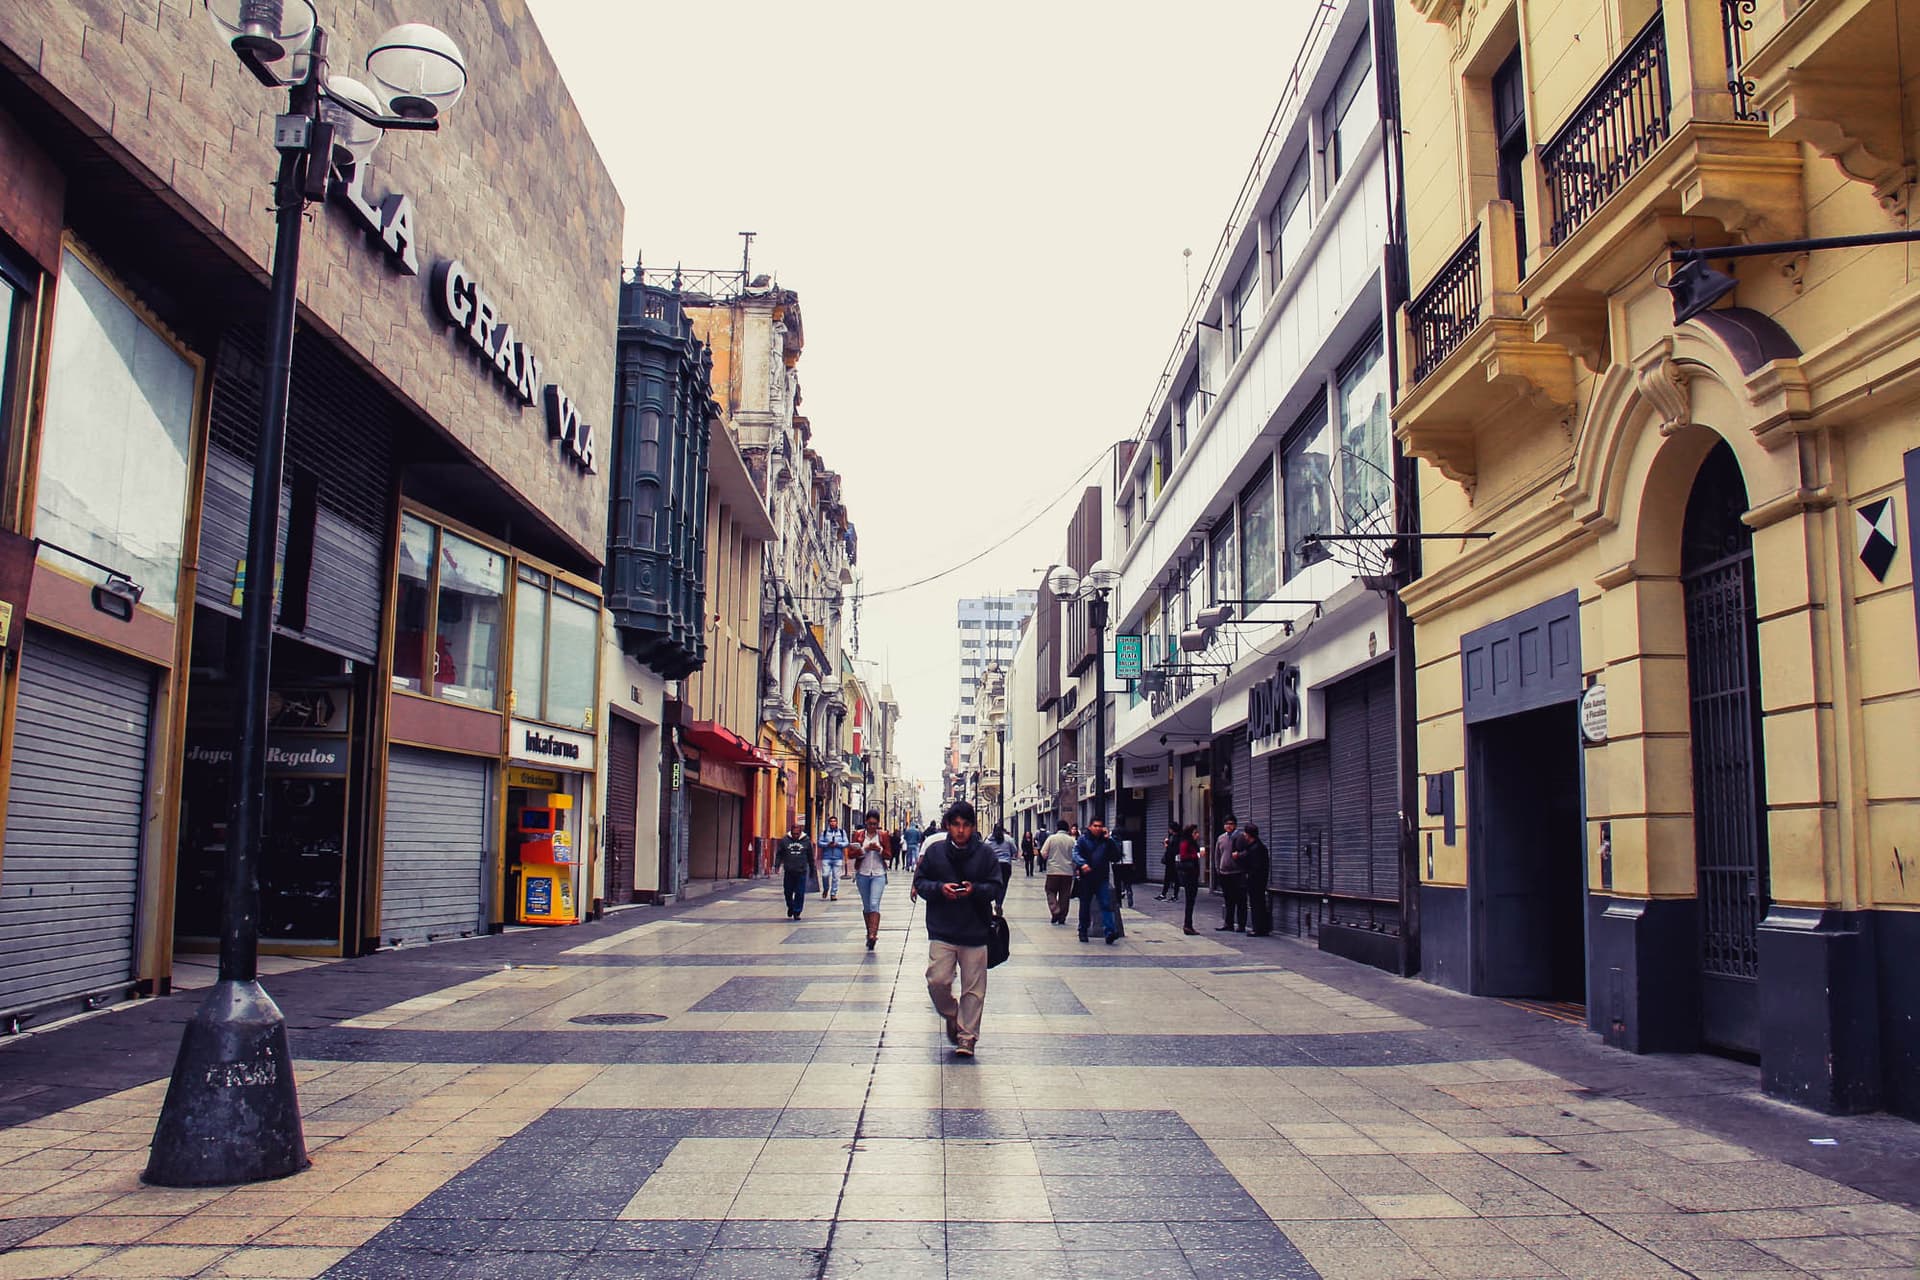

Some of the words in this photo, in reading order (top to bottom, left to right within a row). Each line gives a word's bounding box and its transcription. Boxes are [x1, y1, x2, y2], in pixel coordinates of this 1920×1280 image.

[344, 153, 419, 276] LA
[436, 259, 543, 408] GRAN
[547, 383, 599, 476] VIA
[266, 746, 336, 766] Regalos
[525, 729, 579, 760] Inkafarma
